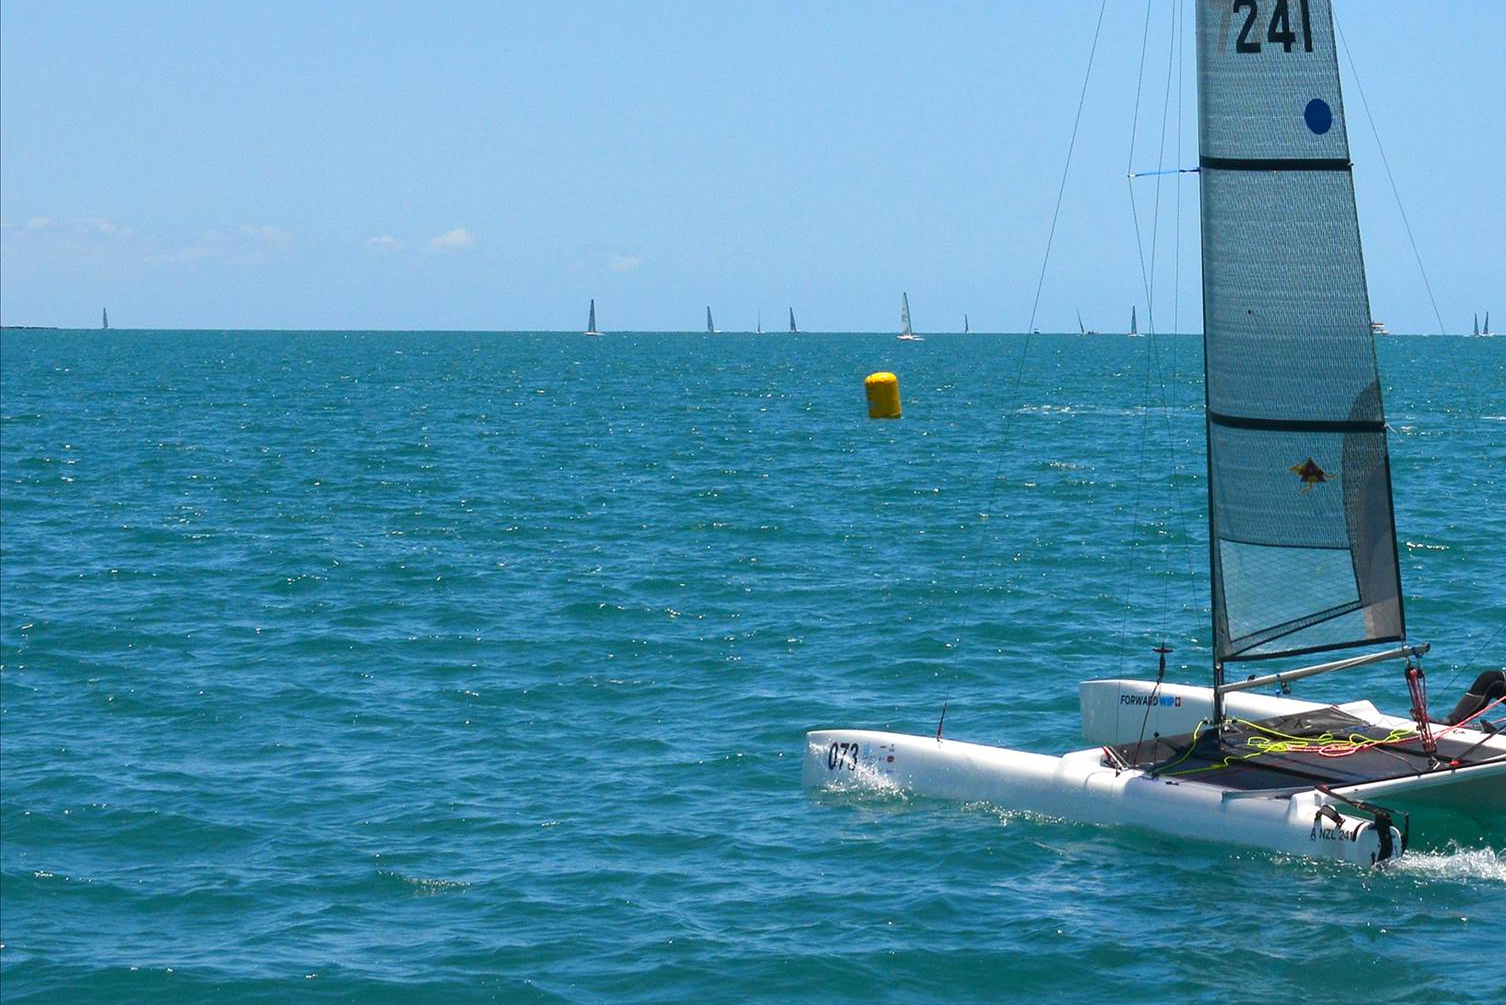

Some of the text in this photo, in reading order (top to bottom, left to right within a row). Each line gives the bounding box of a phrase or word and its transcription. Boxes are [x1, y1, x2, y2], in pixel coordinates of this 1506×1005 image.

[1120, 694, 1174, 706] FORWARD WIP
[828, 741, 859, 771] 073
[1319, 828, 1336, 840] NZL
[1339, 830, 1353, 842] 241
